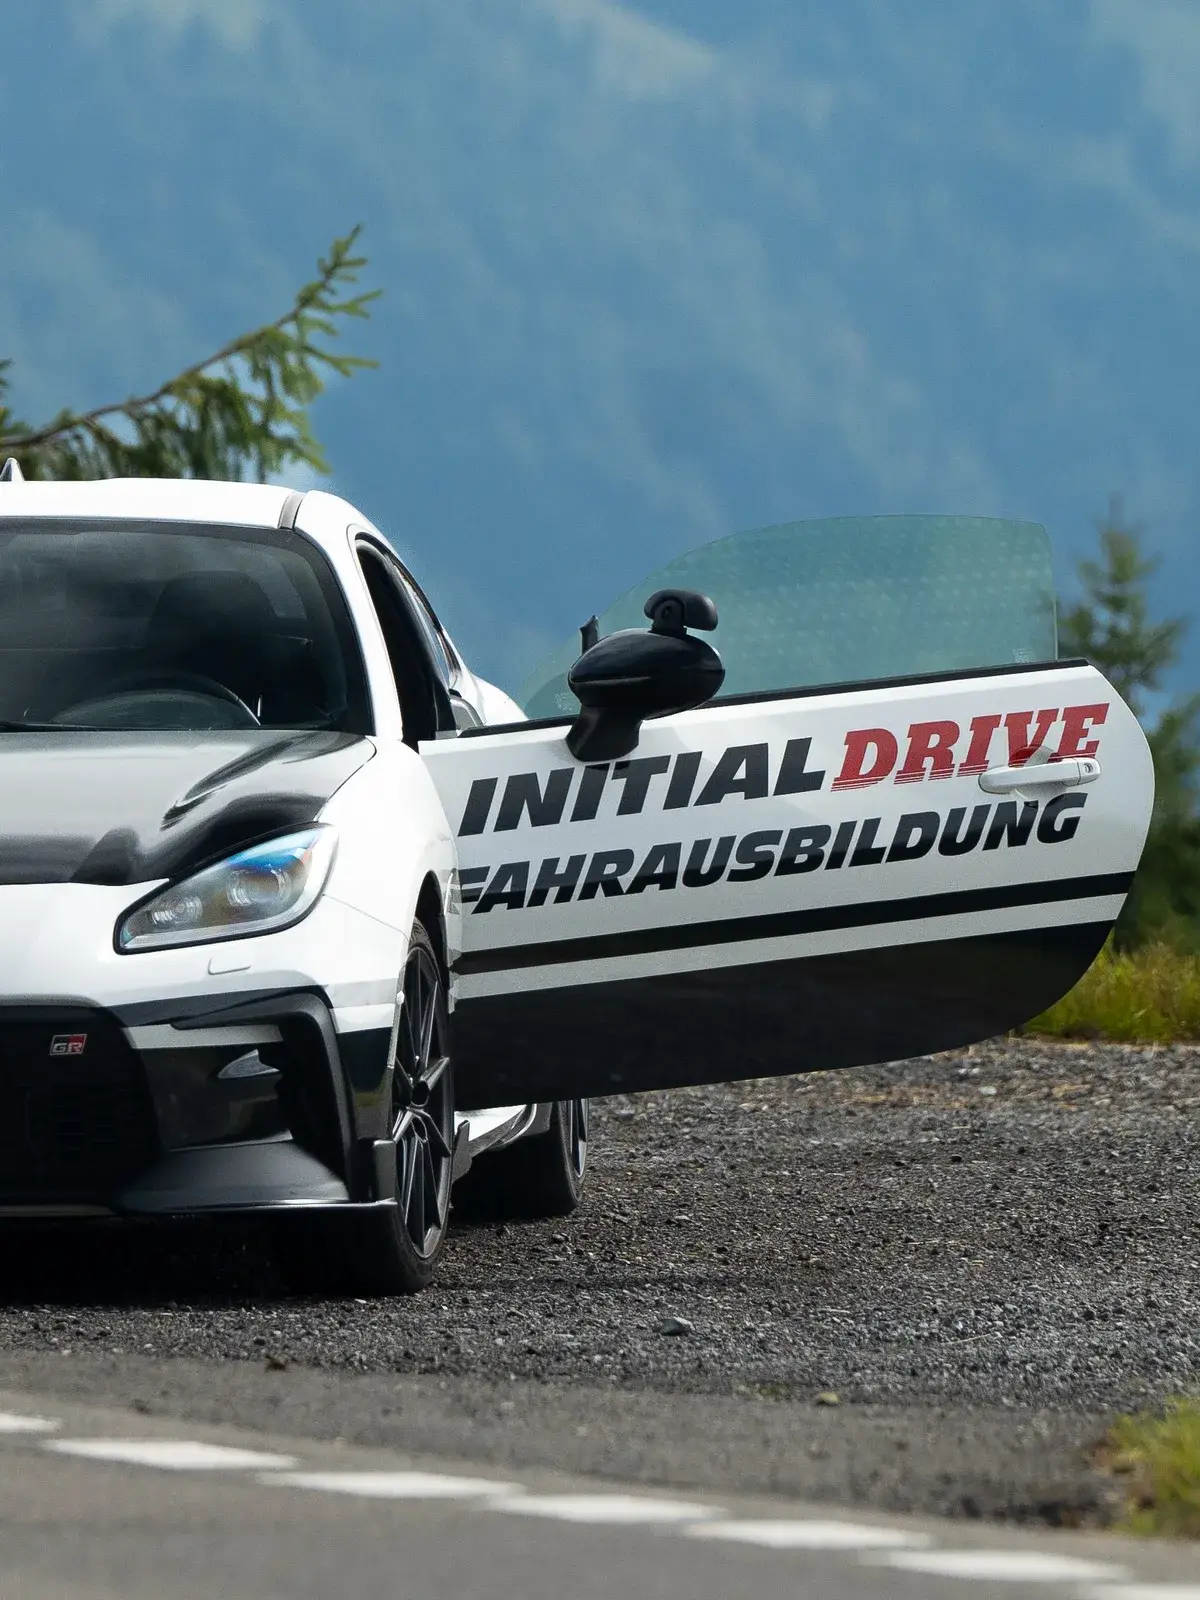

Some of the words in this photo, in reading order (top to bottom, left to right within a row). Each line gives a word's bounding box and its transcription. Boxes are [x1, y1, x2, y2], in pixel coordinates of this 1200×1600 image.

[457, 737, 827, 837] INITIAL
[830, 703, 1110, 792] DRIVE
[458, 792, 1088, 914] FAHRAUSBILDUNG
[52, 1041, 84, 1053] GR
